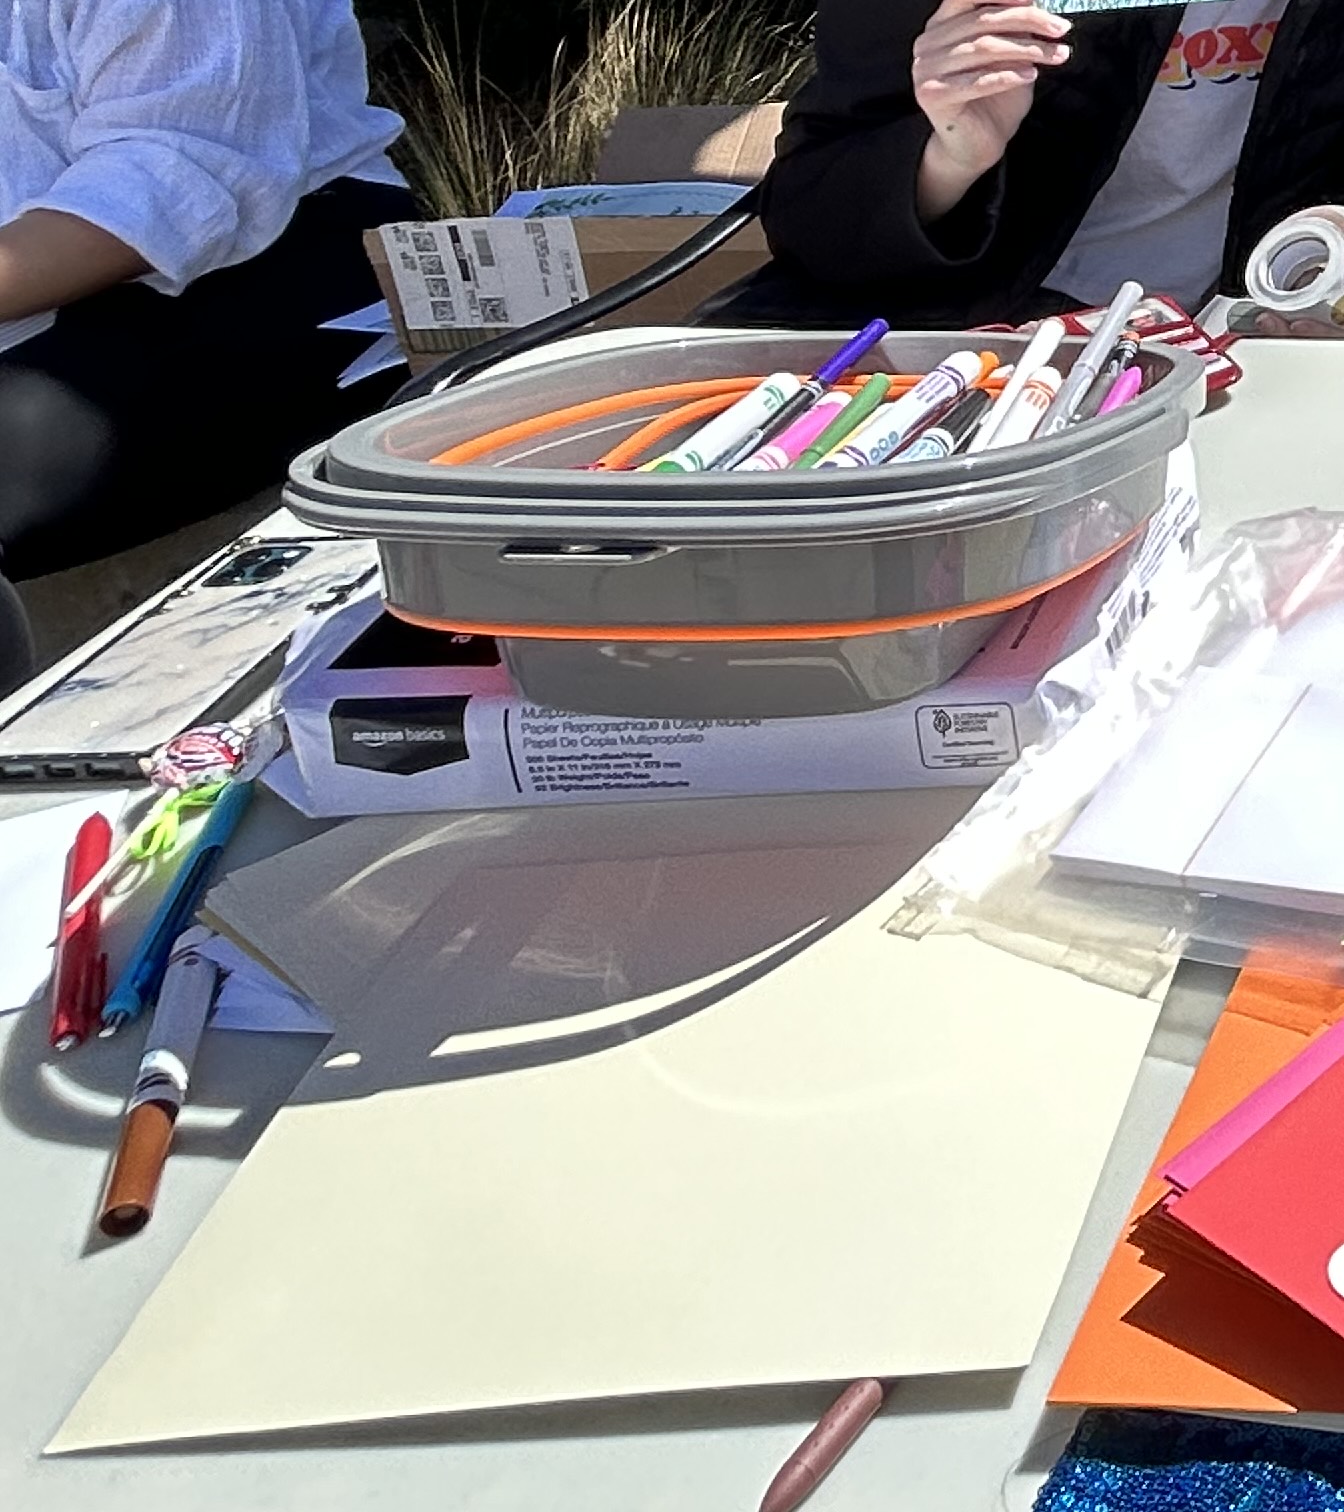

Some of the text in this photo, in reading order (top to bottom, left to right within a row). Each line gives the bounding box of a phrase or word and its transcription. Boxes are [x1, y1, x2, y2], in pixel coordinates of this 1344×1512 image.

[353, 727, 446, 744] amazon basics
[521, 722, 559, 735] Papier
[523, 737, 558, 750] Papel
[560, 737, 578, 748] De
[580, 736, 618, 749] Copia
